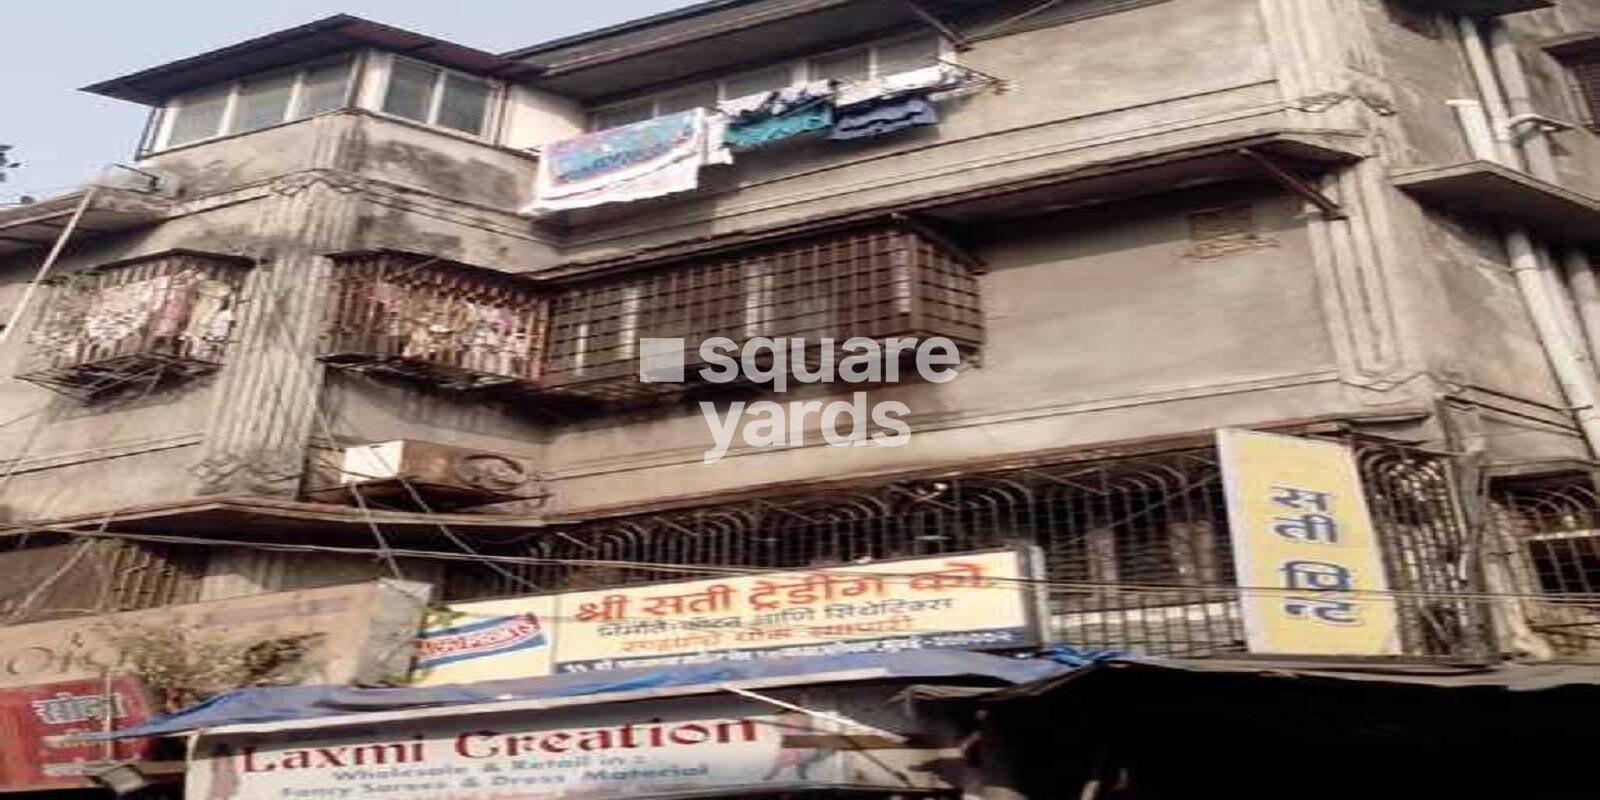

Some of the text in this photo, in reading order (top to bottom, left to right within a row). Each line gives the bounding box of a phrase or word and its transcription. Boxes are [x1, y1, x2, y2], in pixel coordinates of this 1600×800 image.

[574, 594, 629, 622] श्री
[642, 583, 736, 616] सती
[243, 717, 758, 773] Laxmi Creation
[334, 762, 468, 780] Wholesale
[512, 756, 589, 769] Retail
[491, 774, 565, 786] Dress
[583, 763, 709, 780] Material
